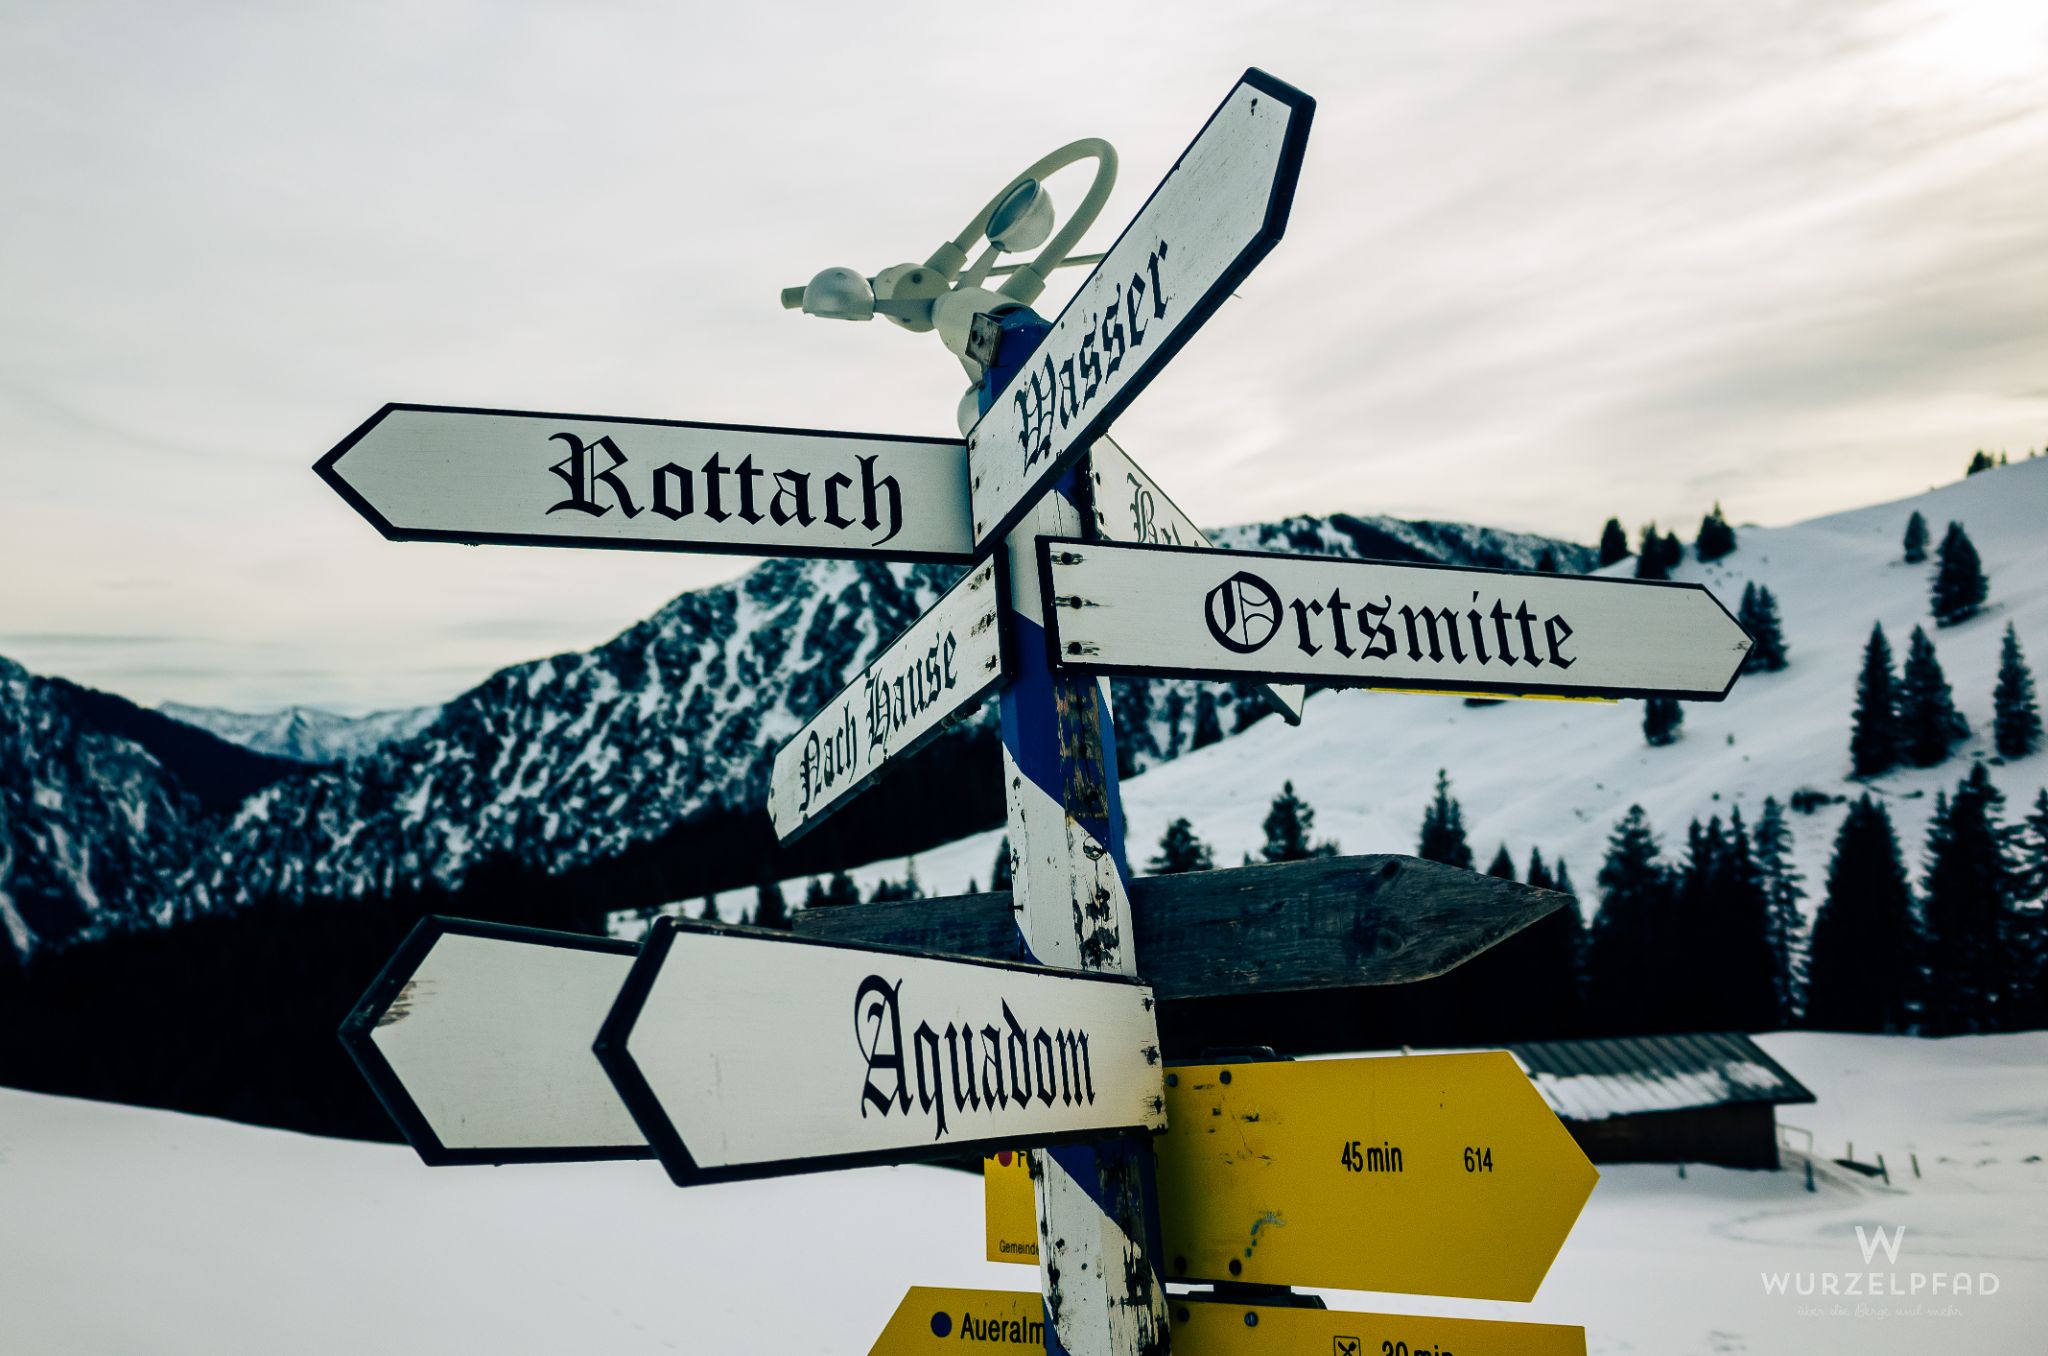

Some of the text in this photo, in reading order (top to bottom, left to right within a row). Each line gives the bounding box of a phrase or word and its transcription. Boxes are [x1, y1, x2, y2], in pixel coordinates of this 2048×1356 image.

[1013, 240, 1173, 476] Wasser
[545, 432, 902, 547] Rottach
[1204, 571, 1577, 669] Ortsmitte
[799, 630, 958, 812] Nach Hause
[854, 974, 1096, 1141] Aquadom
[1341, 1141, 1403, 1173] 45 min
[1464, 1147, 1493, 1173] 614
[960, 1311, 1046, 1348] Aueralm
